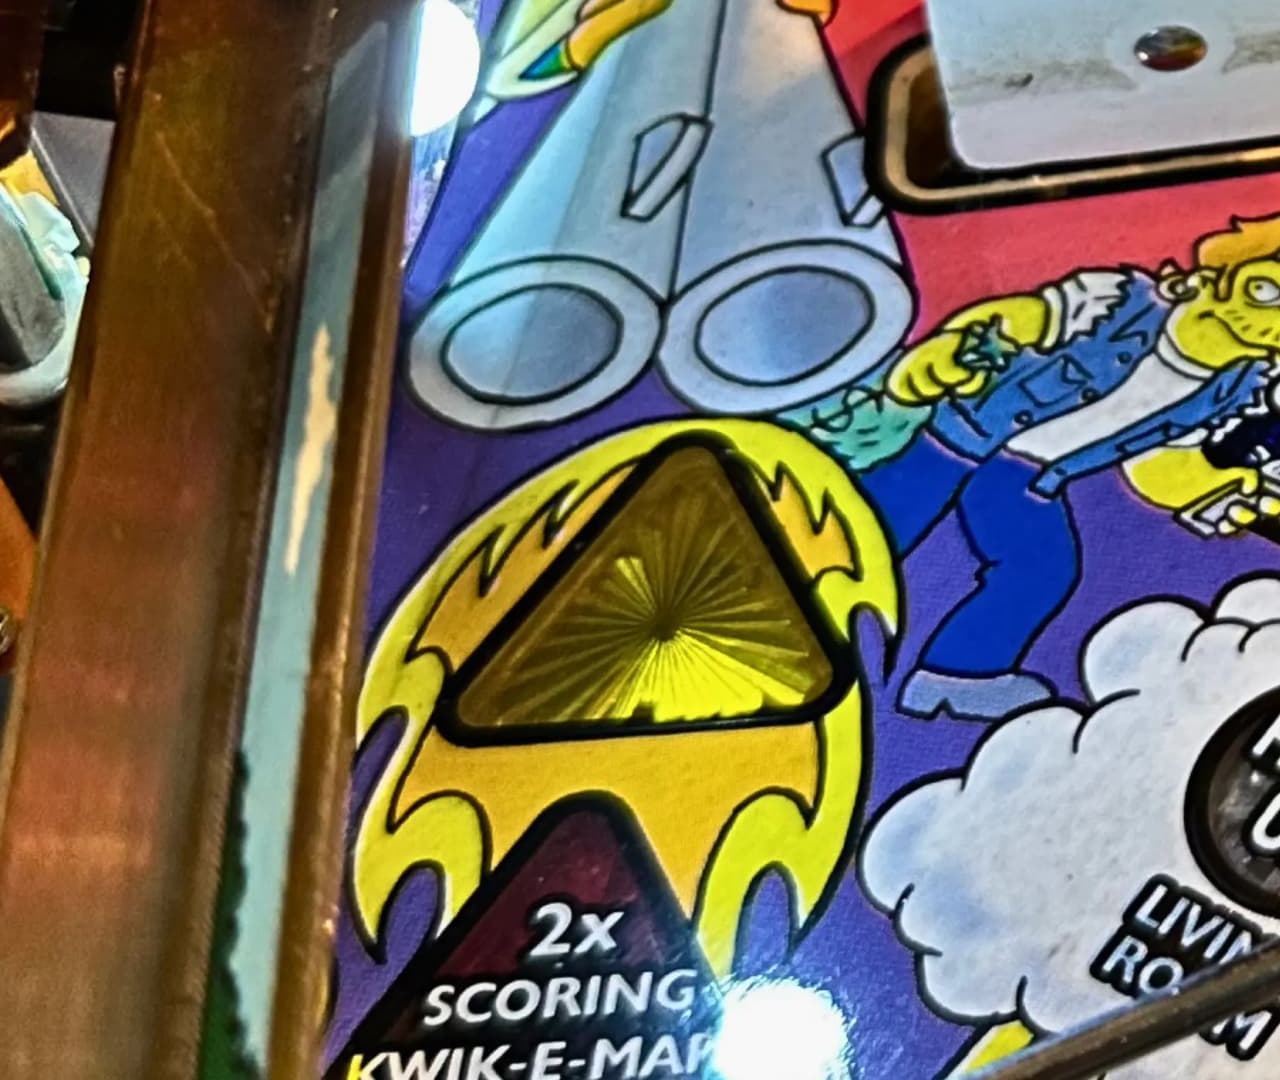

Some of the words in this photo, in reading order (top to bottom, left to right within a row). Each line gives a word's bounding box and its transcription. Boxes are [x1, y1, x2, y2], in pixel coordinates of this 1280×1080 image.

[530, 902, 624, 958] 2x
[424, 968, 698, 1027] SCORING
[1102, 935, 1273, 1050] ROM
